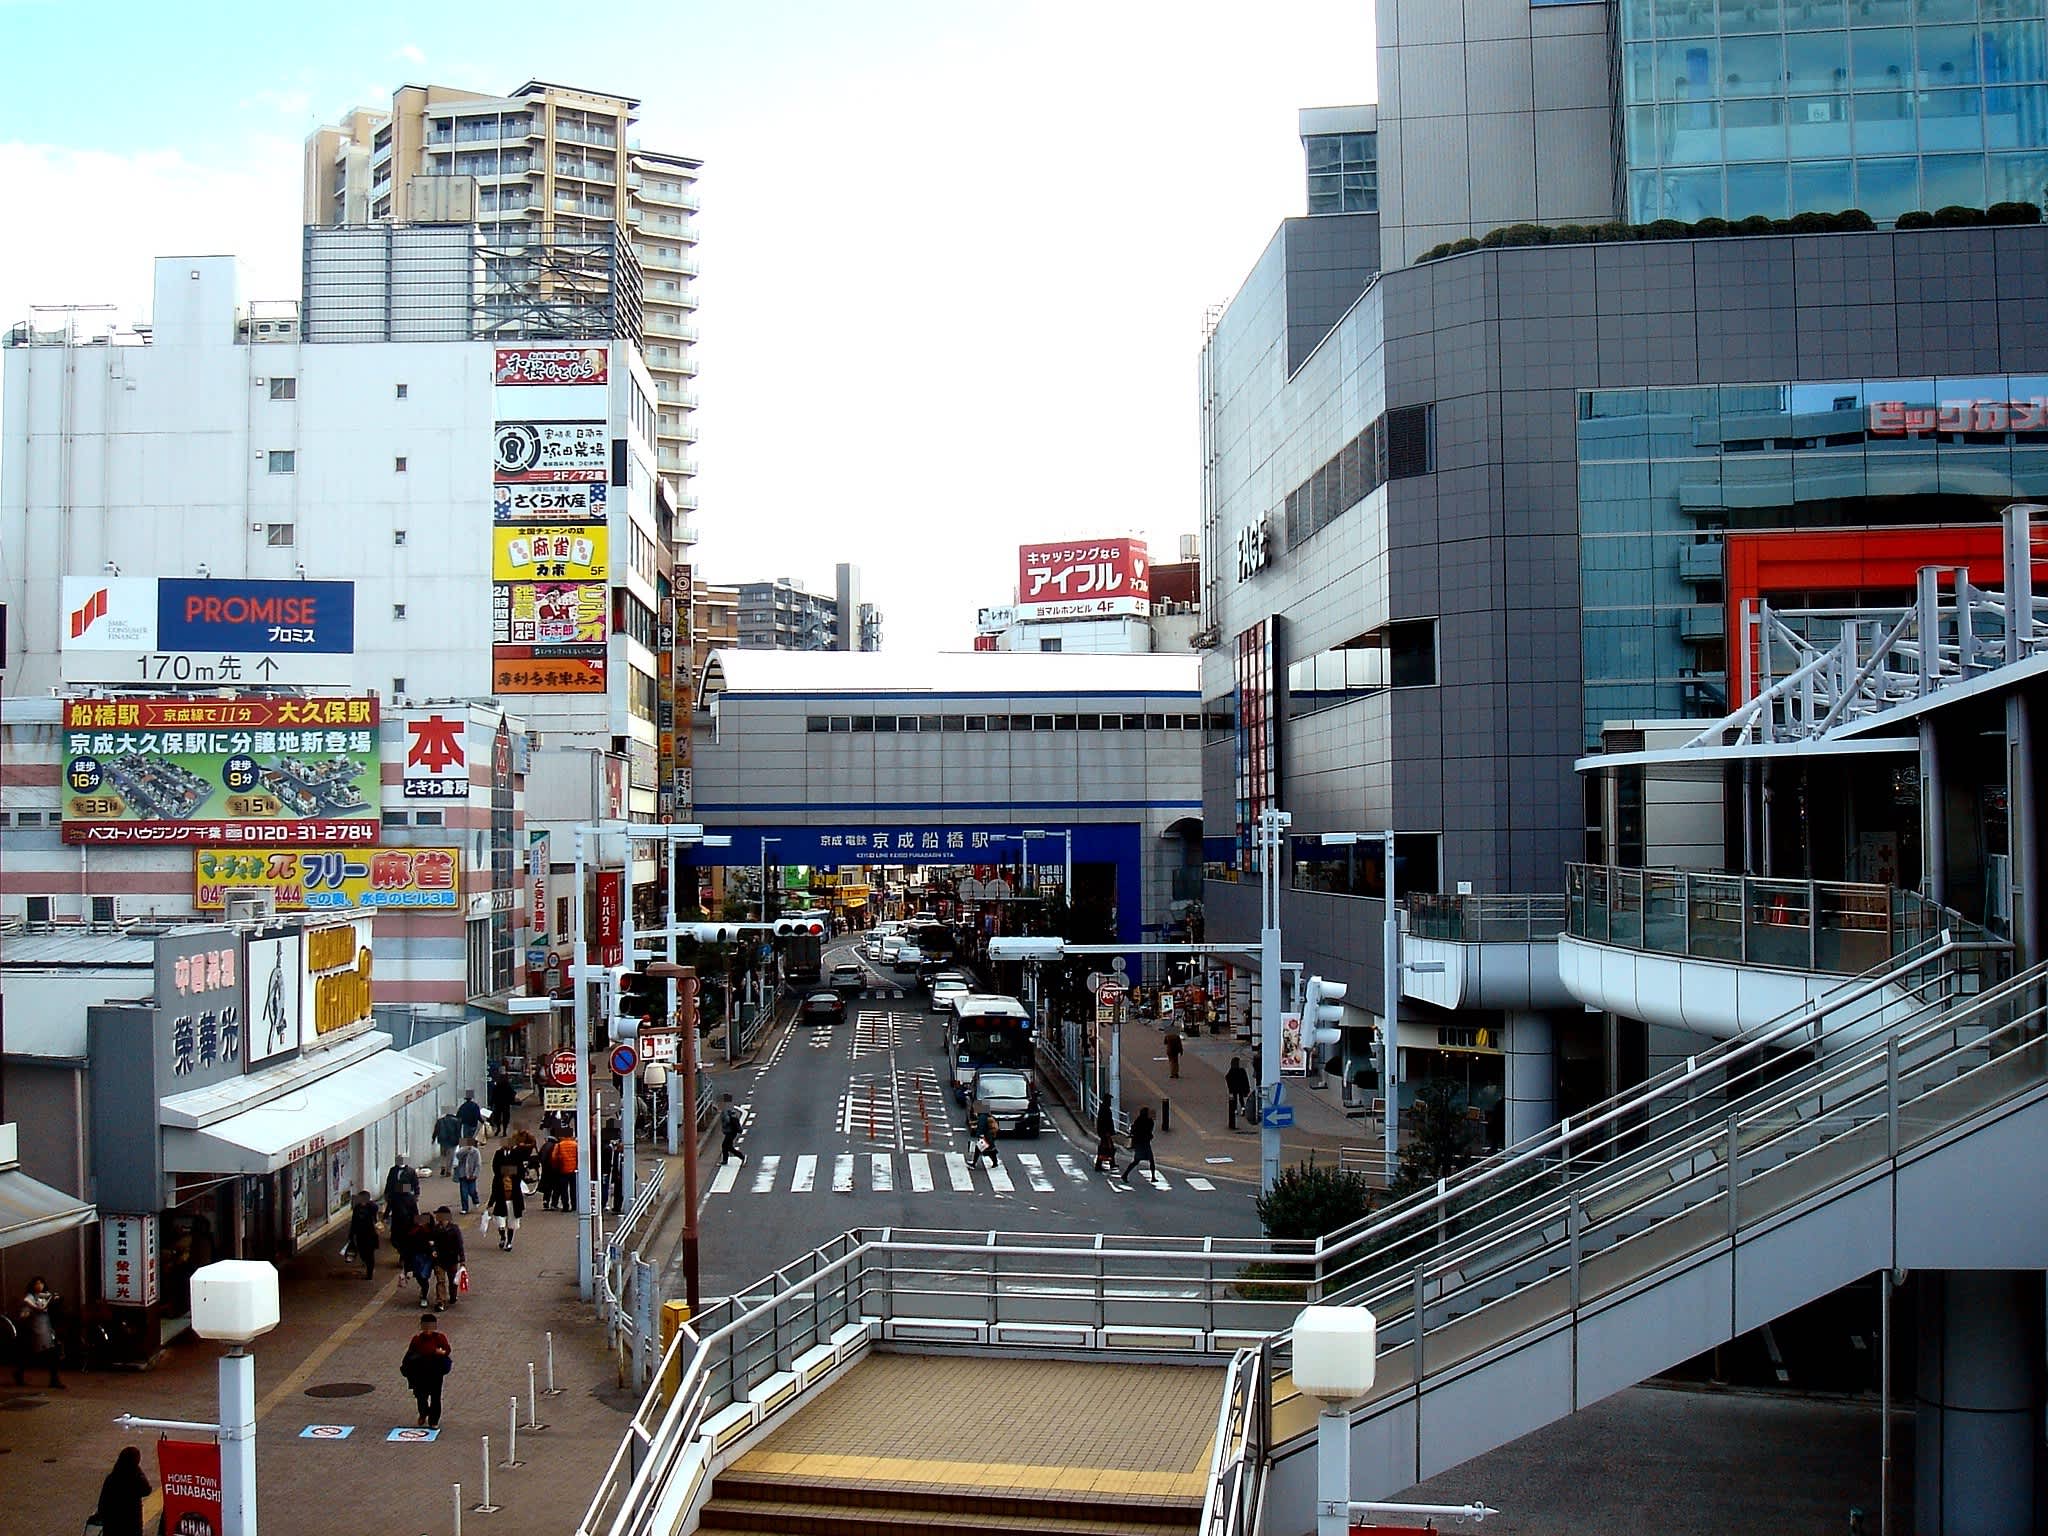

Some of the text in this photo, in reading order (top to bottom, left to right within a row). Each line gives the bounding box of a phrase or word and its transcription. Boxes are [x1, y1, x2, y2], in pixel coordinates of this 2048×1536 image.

[514, 493, 587, 508] さくら水産
[592, 503, 605, 513] 3F
[518, 527, 585, 535] 全国チェーンの店
[533, 536, 570, 557] 麻雀
[1027, 547, 1120, 565] キャッシングなら
[590, 567, 604, 577] 5F
[1027, 562, 1123, 596] アイフル
[185, 596, 316, 625] PROMISE
[1037, 601, 1115, 617] 当マルホンビル 4F
[268, 626, 316, 643] プロミス
[514, 631, 534, 640] 4F
[137, 655, 242, 681] 170m先
[70, 704, 140, 726] 船橋駅
[163, 706, 252, 722] 京成線で11分
[278, 701, 371, 724] 大久保駅
[70, 731, 371, 755] 京成大久保駅に分譲地新登場
[408, 715, 464, 773] 本
[75, 761, 96, 772] 徒歩
[230, 760, 252, 772] 徒歩
[72, 772, 100, 788] 16分
[230, 772, 253, 787] 9分
[404, 780, 468, 796] ときわ書房
[88, 826, 373, 840] ベストハウジング千葉 0120-31-2784
[872, 831, 989, 849] 京成船橋駅
[602, 896, 611, 937] リハウス
[167, 1473, 217, 1487] HOME TOWN
[165, 1483, 221, 1502] FUNABASHI
